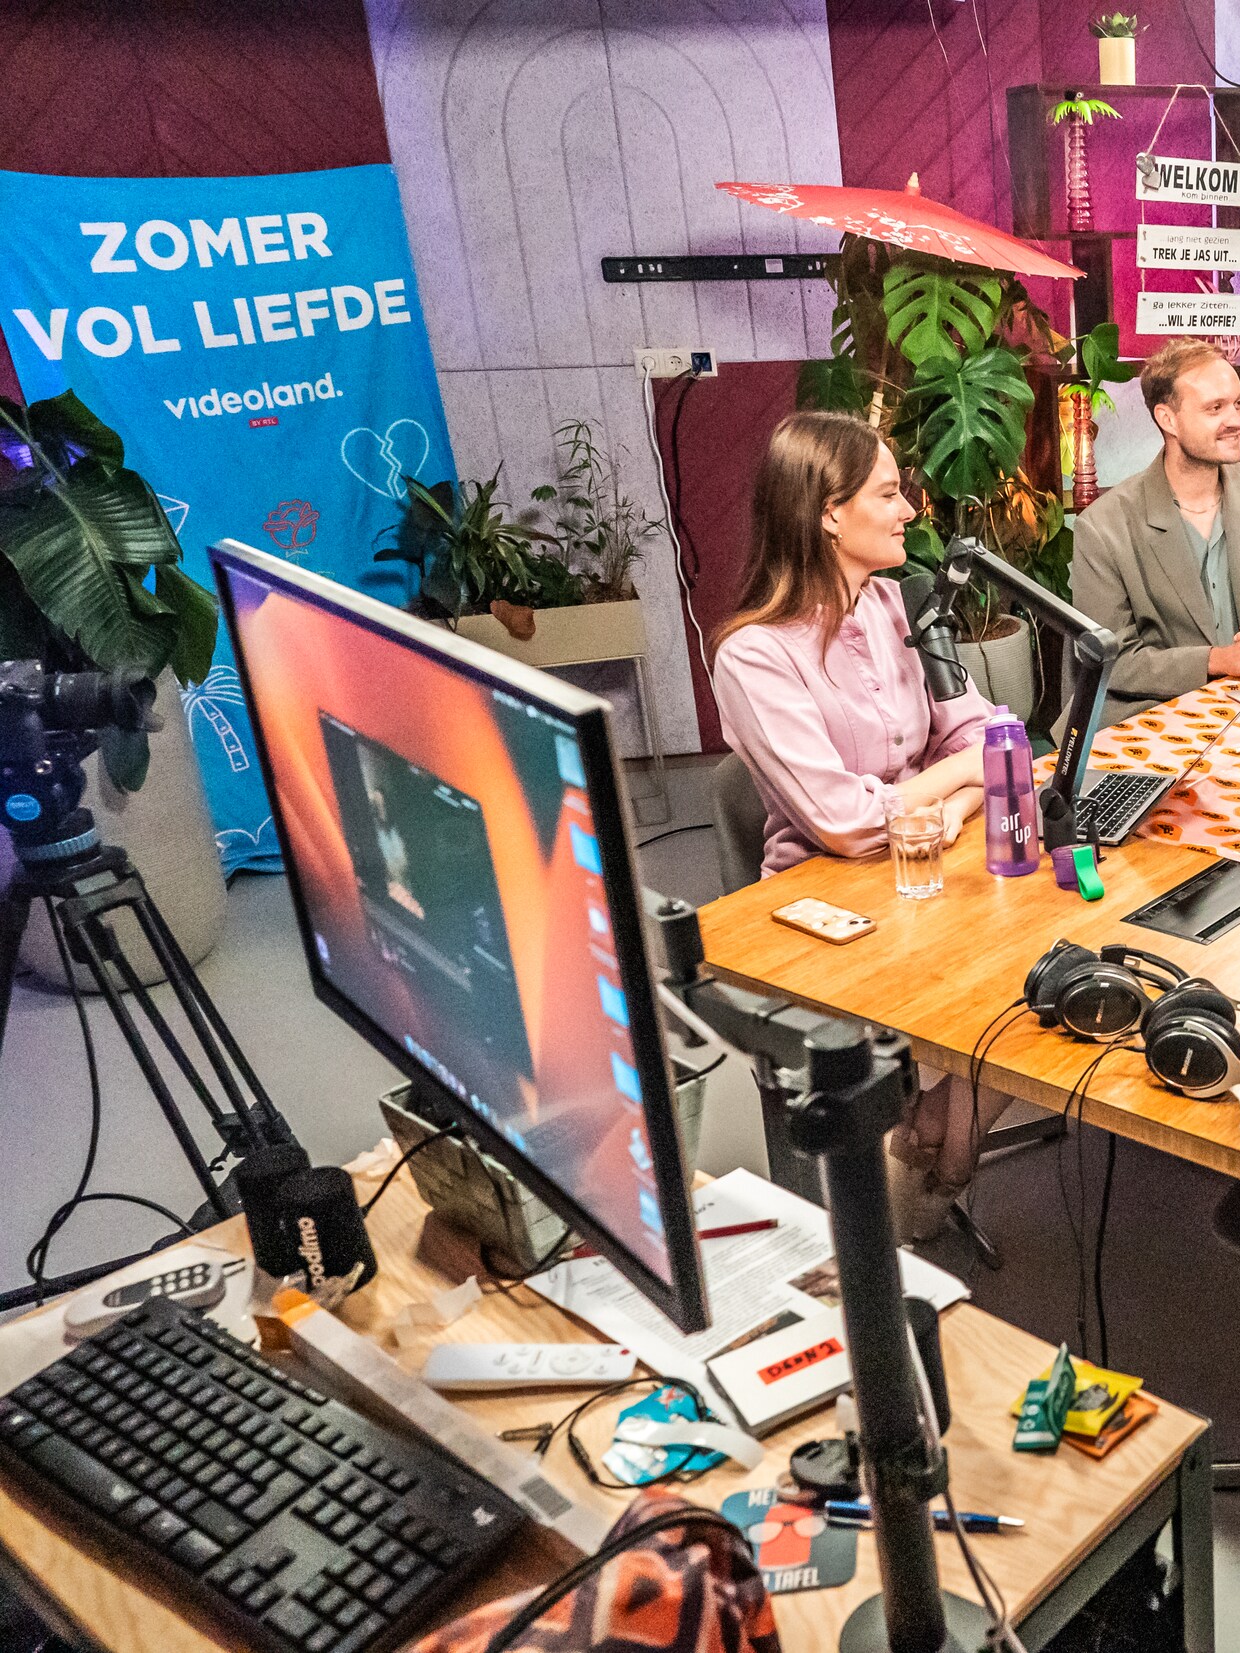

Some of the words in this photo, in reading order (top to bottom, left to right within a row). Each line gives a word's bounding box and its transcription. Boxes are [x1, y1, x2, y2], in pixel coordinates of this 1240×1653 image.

[1154, 163, 1238, 193] WELKOM
[1181, 191, 1198, 199] kom
[80, 212, 333, 273] ZOMER
[1204, 236, 1230, 245] gezien
[1153, 248, 1177, 260] TREK
[1180, 249, 1191, 261] JE
[1194, 249, 1211, 262] JAS
[1213, 250, 1237, 263] UIT...
[1152, 301, 1164, 310] ga
[1167, 301, 1197, 309] lekker
[13, 305, 181, 361] VOL
[193, 278, 412, 349] LIEFDE
[1158, 315, 1184, 327] ...WIL
[1187, 315, 1198, 327] JE
[1200, 315, 1237, 328] KOFFIE?
[1062, 734, 1078, 776] YELLOWTEC
[1000, 812, 1020, 832] air
[1015, 825, 1031, 844] up
[773, 1567, 821, 1591] TAFEL
